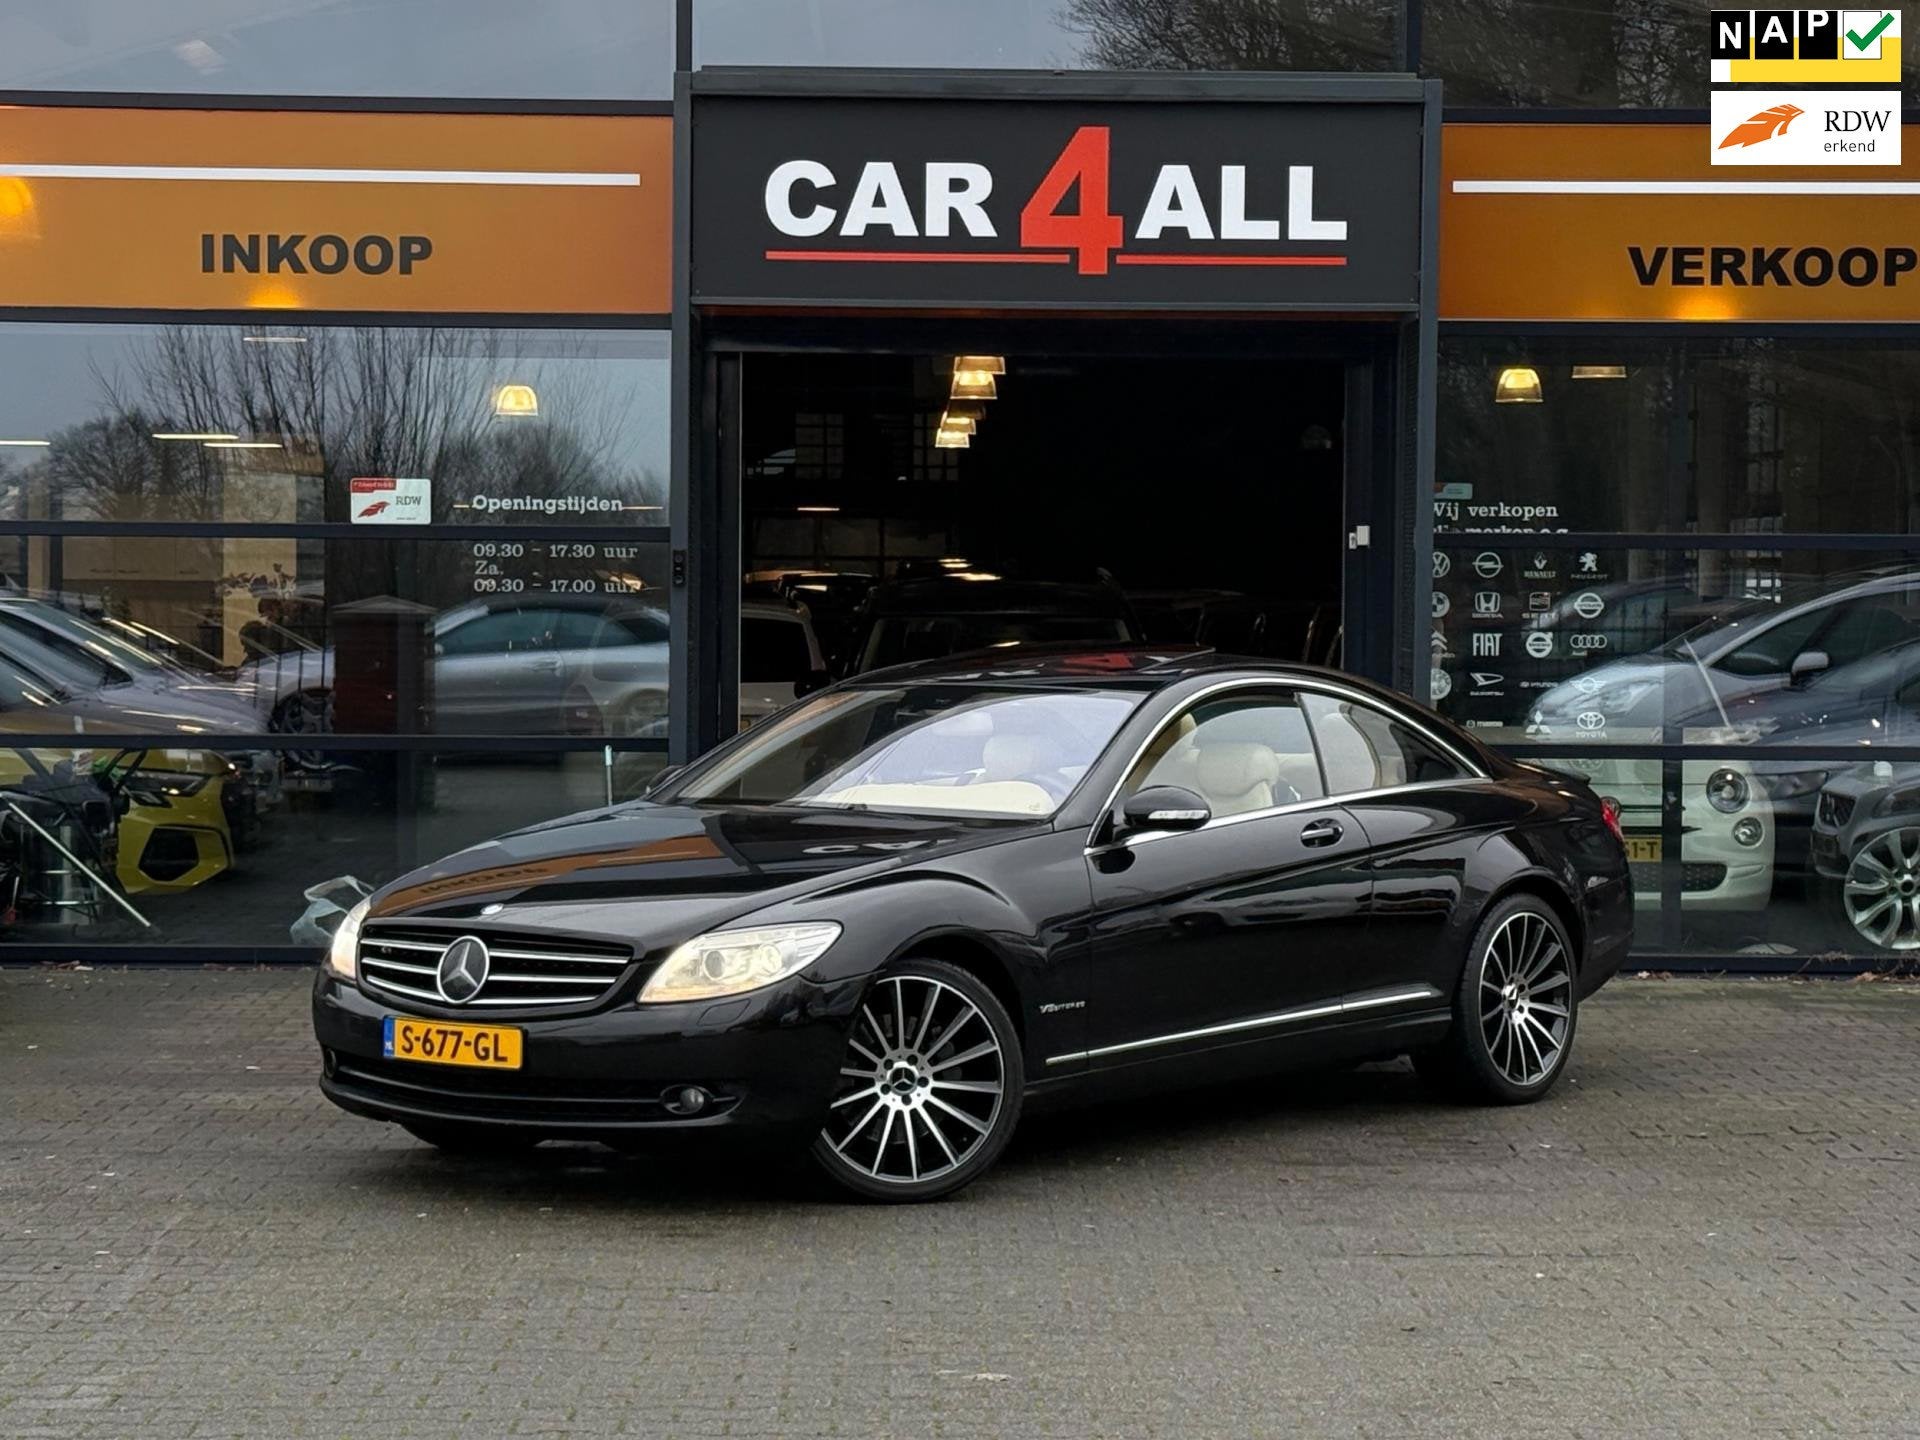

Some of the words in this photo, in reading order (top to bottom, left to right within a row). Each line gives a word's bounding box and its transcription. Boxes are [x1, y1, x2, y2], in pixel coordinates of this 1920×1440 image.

[201, 234, 433, 275] INKOOP
[1627, 246, 1918, 287] VERKOOP
[395, 495, 422, 506] RDW
[472, 494, 624, 514] Openingstijden
[1467, 502, 1559, 521] verkopen
[473, 543, 524, 558] 09.30
[549, 544, 595, 558] 17.30
[603, 547, 638, 558] uur
[474, 560, 504, 576] Za.
[473, 578, 524, 592] 09.30
[549, 578, 596, 593] 17.00
[1472, 633, 1503, 656] FIAT
[401, 1025, 508, 1062] S-677-GL
